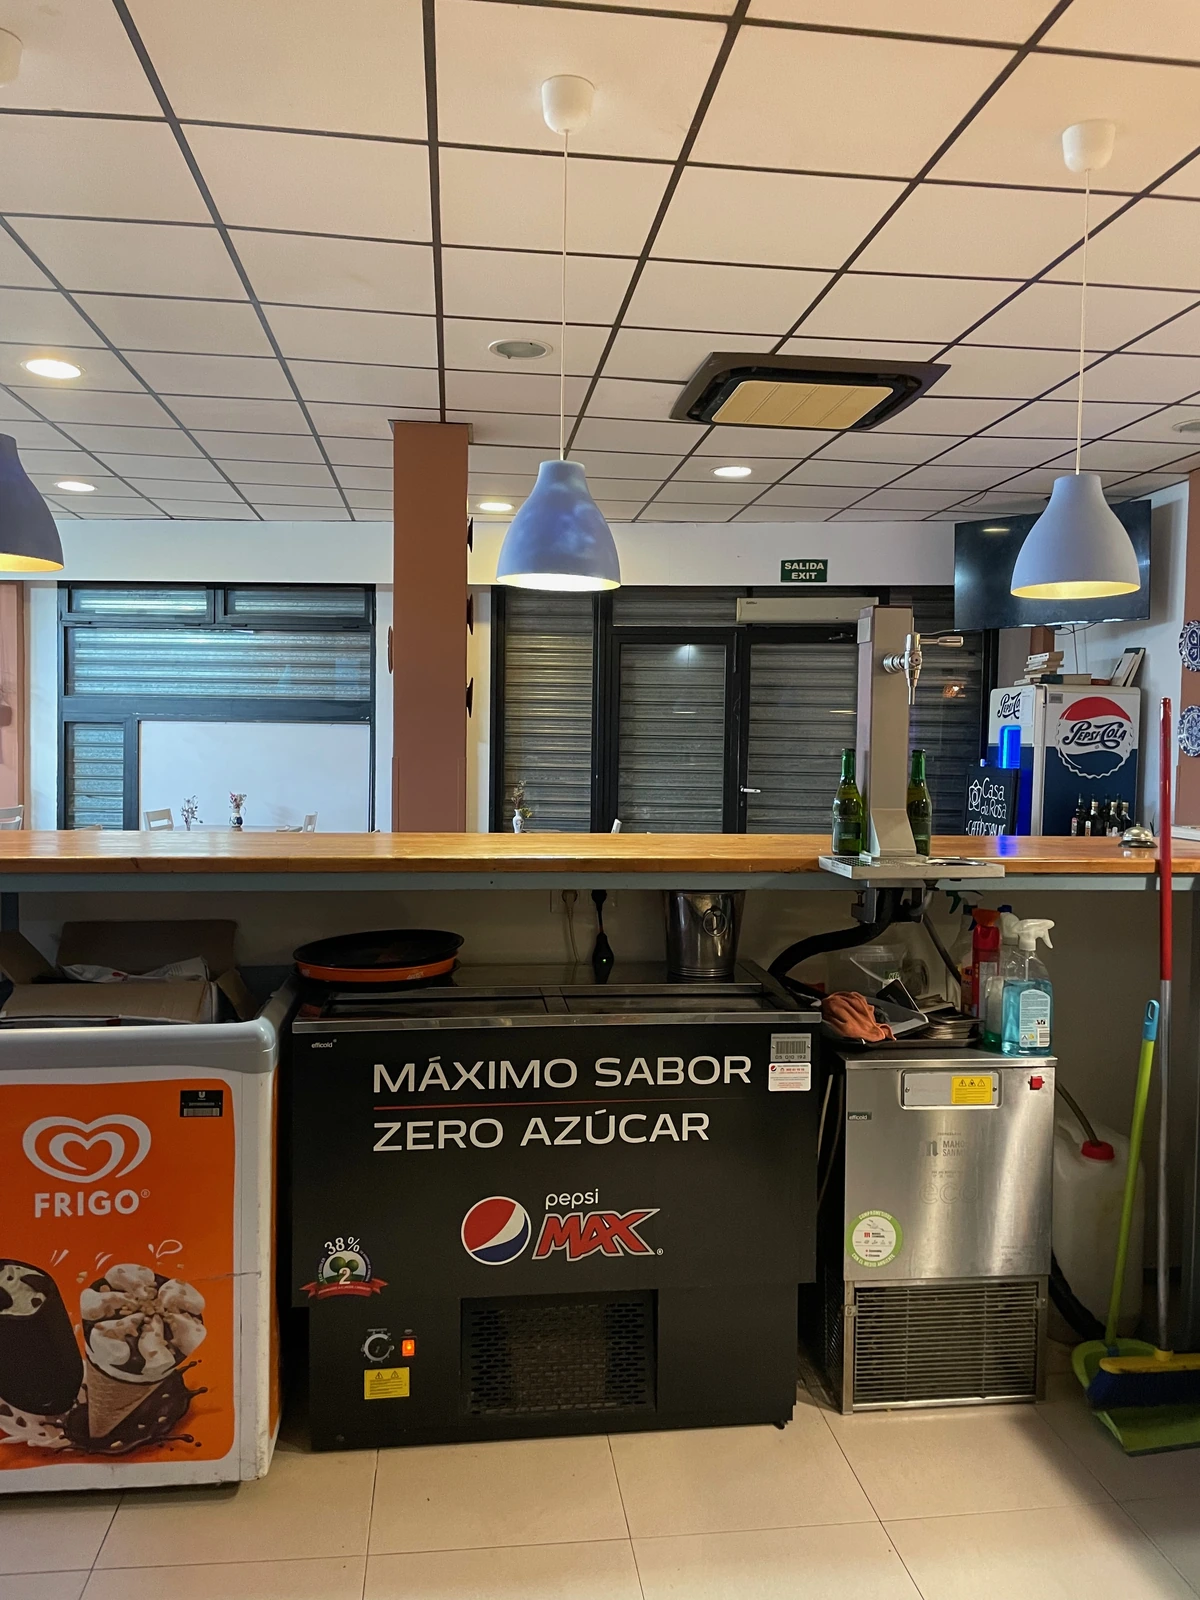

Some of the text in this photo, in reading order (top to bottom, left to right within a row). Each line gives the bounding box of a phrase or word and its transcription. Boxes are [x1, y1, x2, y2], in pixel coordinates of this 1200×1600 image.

[784, 562, 825, 570] SALIDA
[791, 572, 817, 580] EXIT
[982, 777, 1005, 801] Casa
[980, 799, 1006, 819] de Rosa
[373, 1055, 752, 1094] MÁXIMO SABOR
[373, 1108, 710, 1152] ZERO AZÚCAR
[34, 1189, 140, 1218] FRIGO
[545, 1188, 599, 1211] pepsi
[532, 1208, 661, 1262] MAX
[339, 1267, 351, 1285] 2
